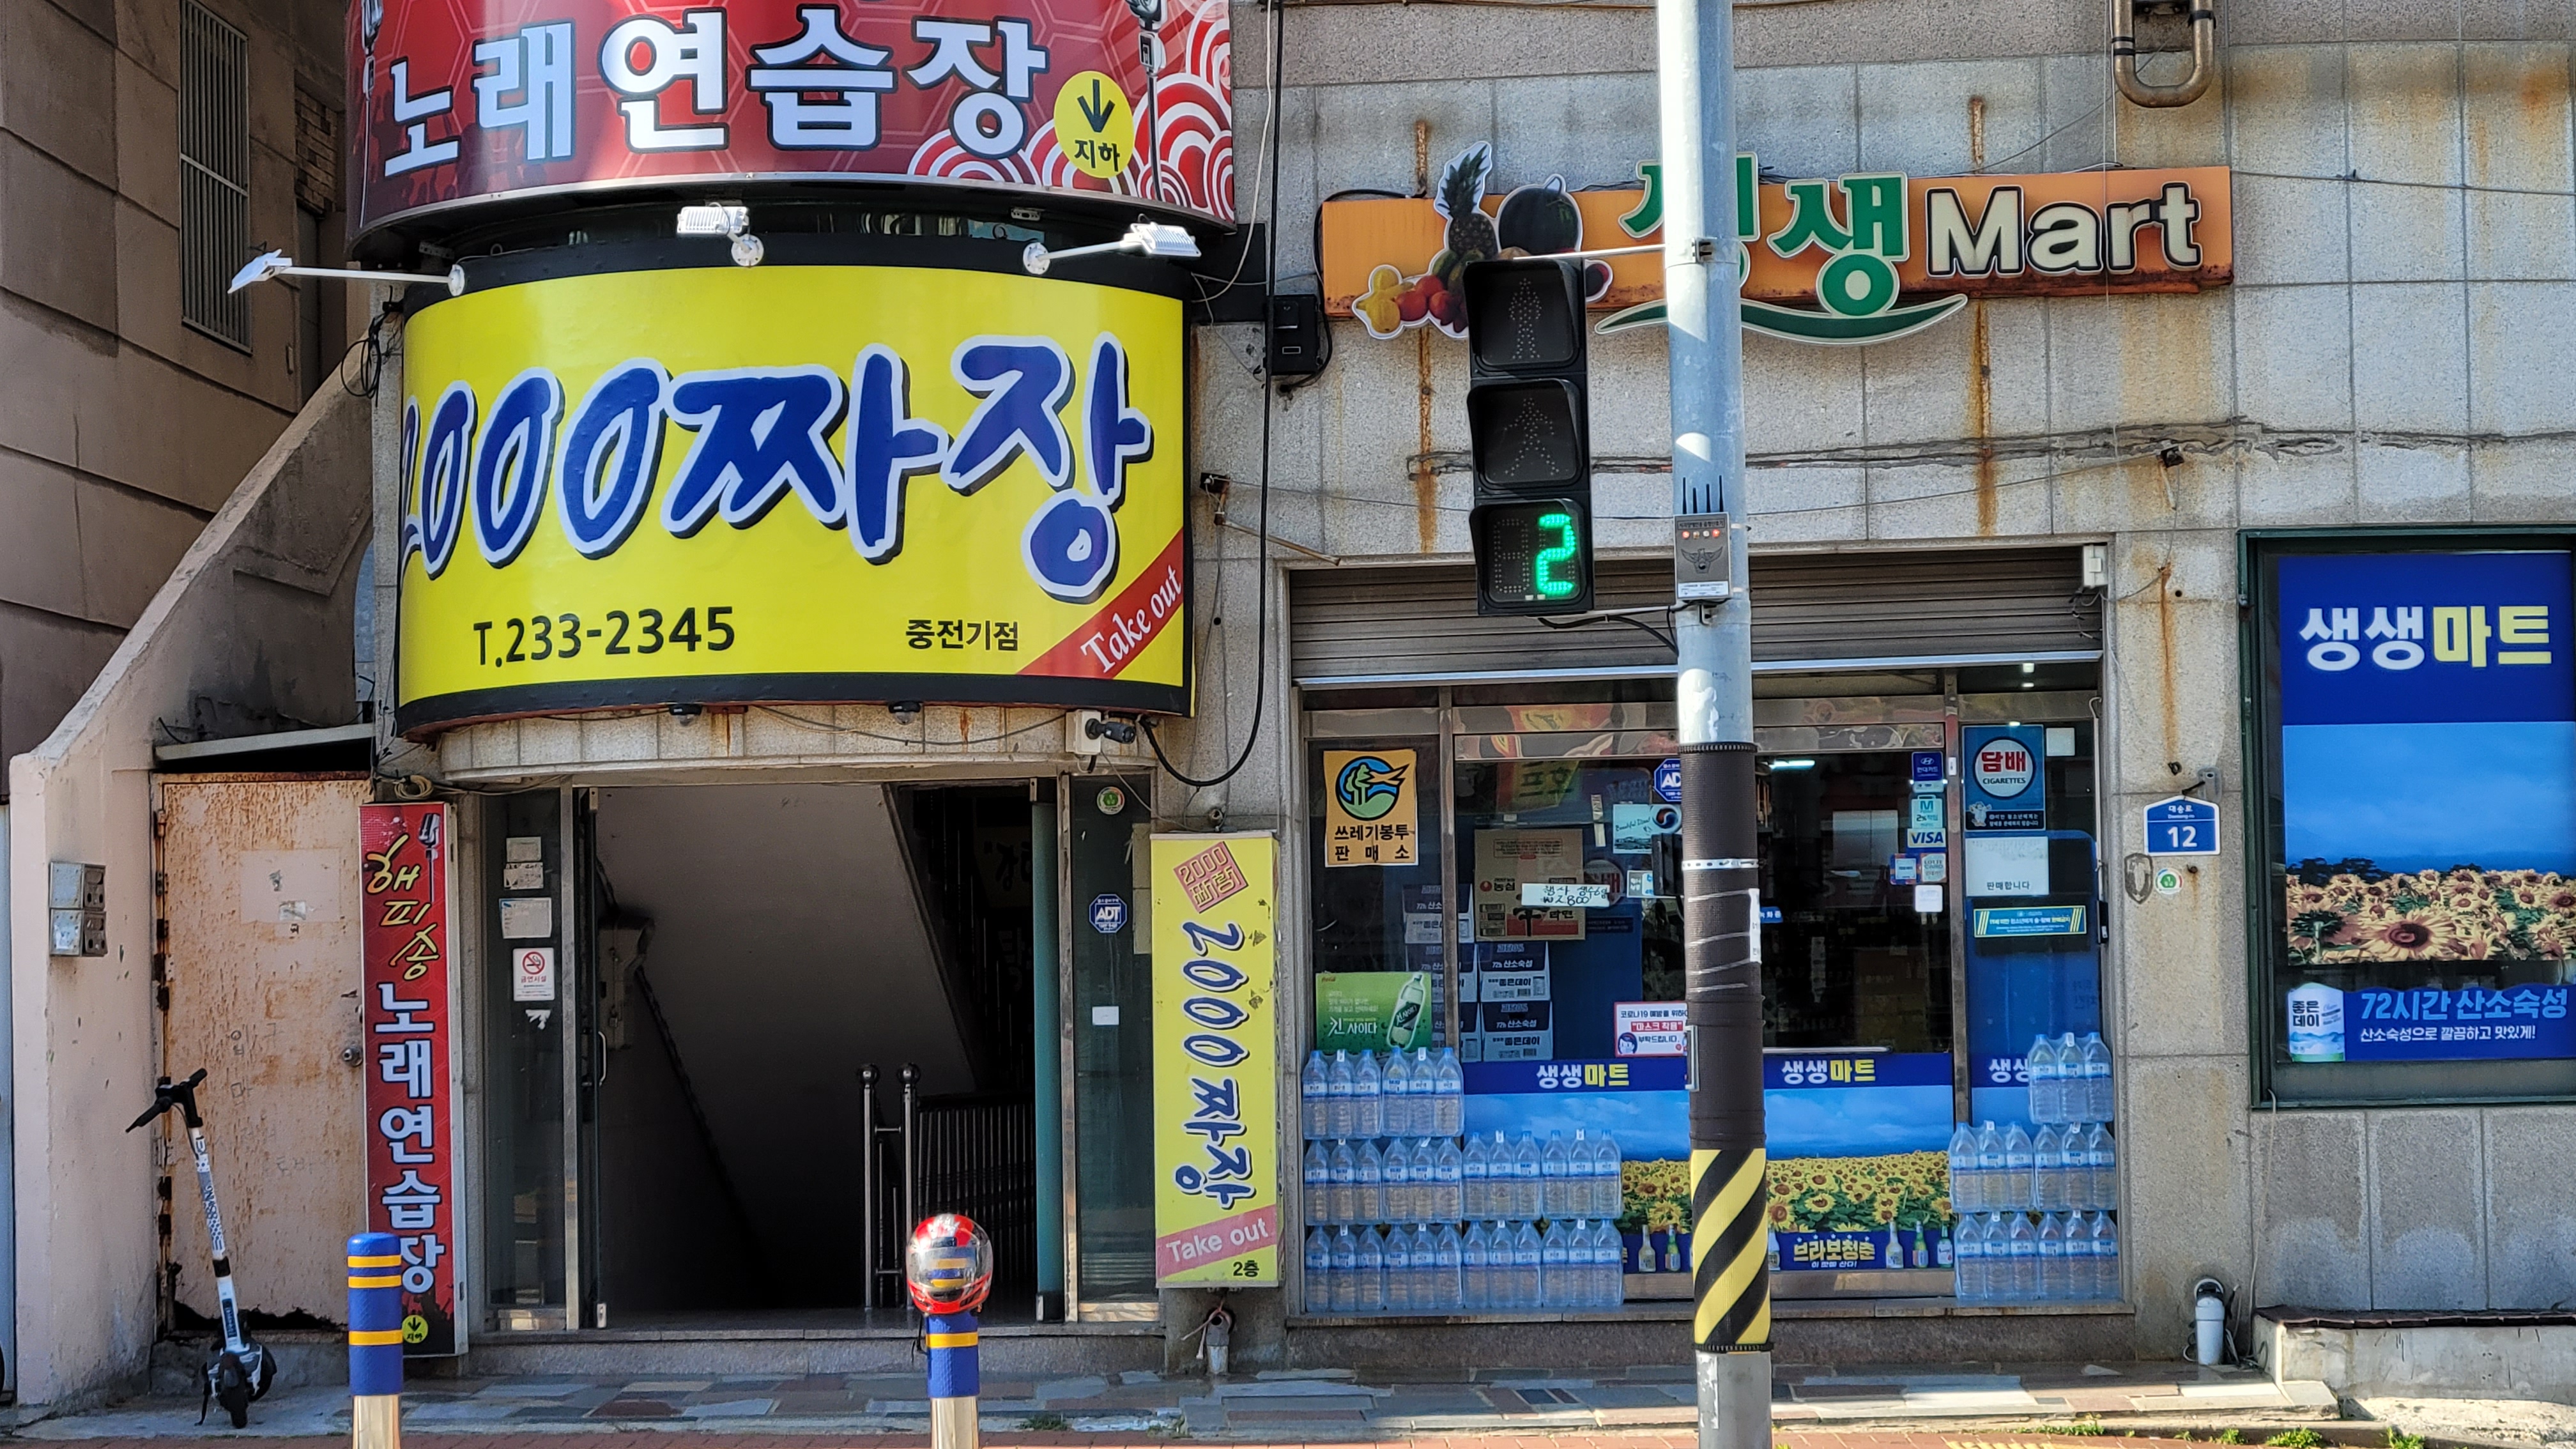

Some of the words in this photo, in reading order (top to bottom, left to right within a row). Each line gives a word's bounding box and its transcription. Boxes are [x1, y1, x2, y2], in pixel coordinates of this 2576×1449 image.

[385, 5, 1048, 178] 노래연습장
[1073, 141, 1122, 173] 지하
[1924, 181, 2204, 279] Mart
[1080, 609, 1151, 673] Take
[1151, 564, 1182, 619] out
[473, 606, 735, 670] T.233-2345
[905, 618, 1020, 653] 중전기점
[2299, 604, 2553, 671] 생생마트
[1981, 751, 2027, 772] 담배
[1660, 772, 1682, 788] AD
[1334, 824, 1409, 841] 쓰레기봉투
[1912, 831, 1944, 844] VISA
[2167, 825, 2198, 848] 12
[1986, 881, 2030, 891] 판매합니다
[366, 834, 439, 980] 해피송
[1095, 906, 1121, 921] ADT
[2292, 1000, 2320, 1014] 좋은
[2361, 990, 2451, 1021] 72시간
[2456, 988, 2568, 1019] 산소숙성
[1347, 1022, 1377, 1034] 사이다
[2292, 1013, 2320, 1028] 데이
[2360, 1027, 2438, 1043] 산소숙성으로
[2441, 1025, 2491, 1041] 깔끔하고
[2494, 1025, 2536, 1041] 맛있게!
[1175, 919, 1257, 1210] 2000짜장
[1536, 1063, 1630, 1090] 생생마트
[1781, 1058, 1876, 1085] 생생마트
[374, 982, 445, 1295] 노래연습장
[1166, 1232, 1223, 1266] Take
[1230, 1216, 1269, 1246] out
[1793, 1238, 1875, 1262] 브라보청춘
[1232, 1259, 1261, 1278] 2층
